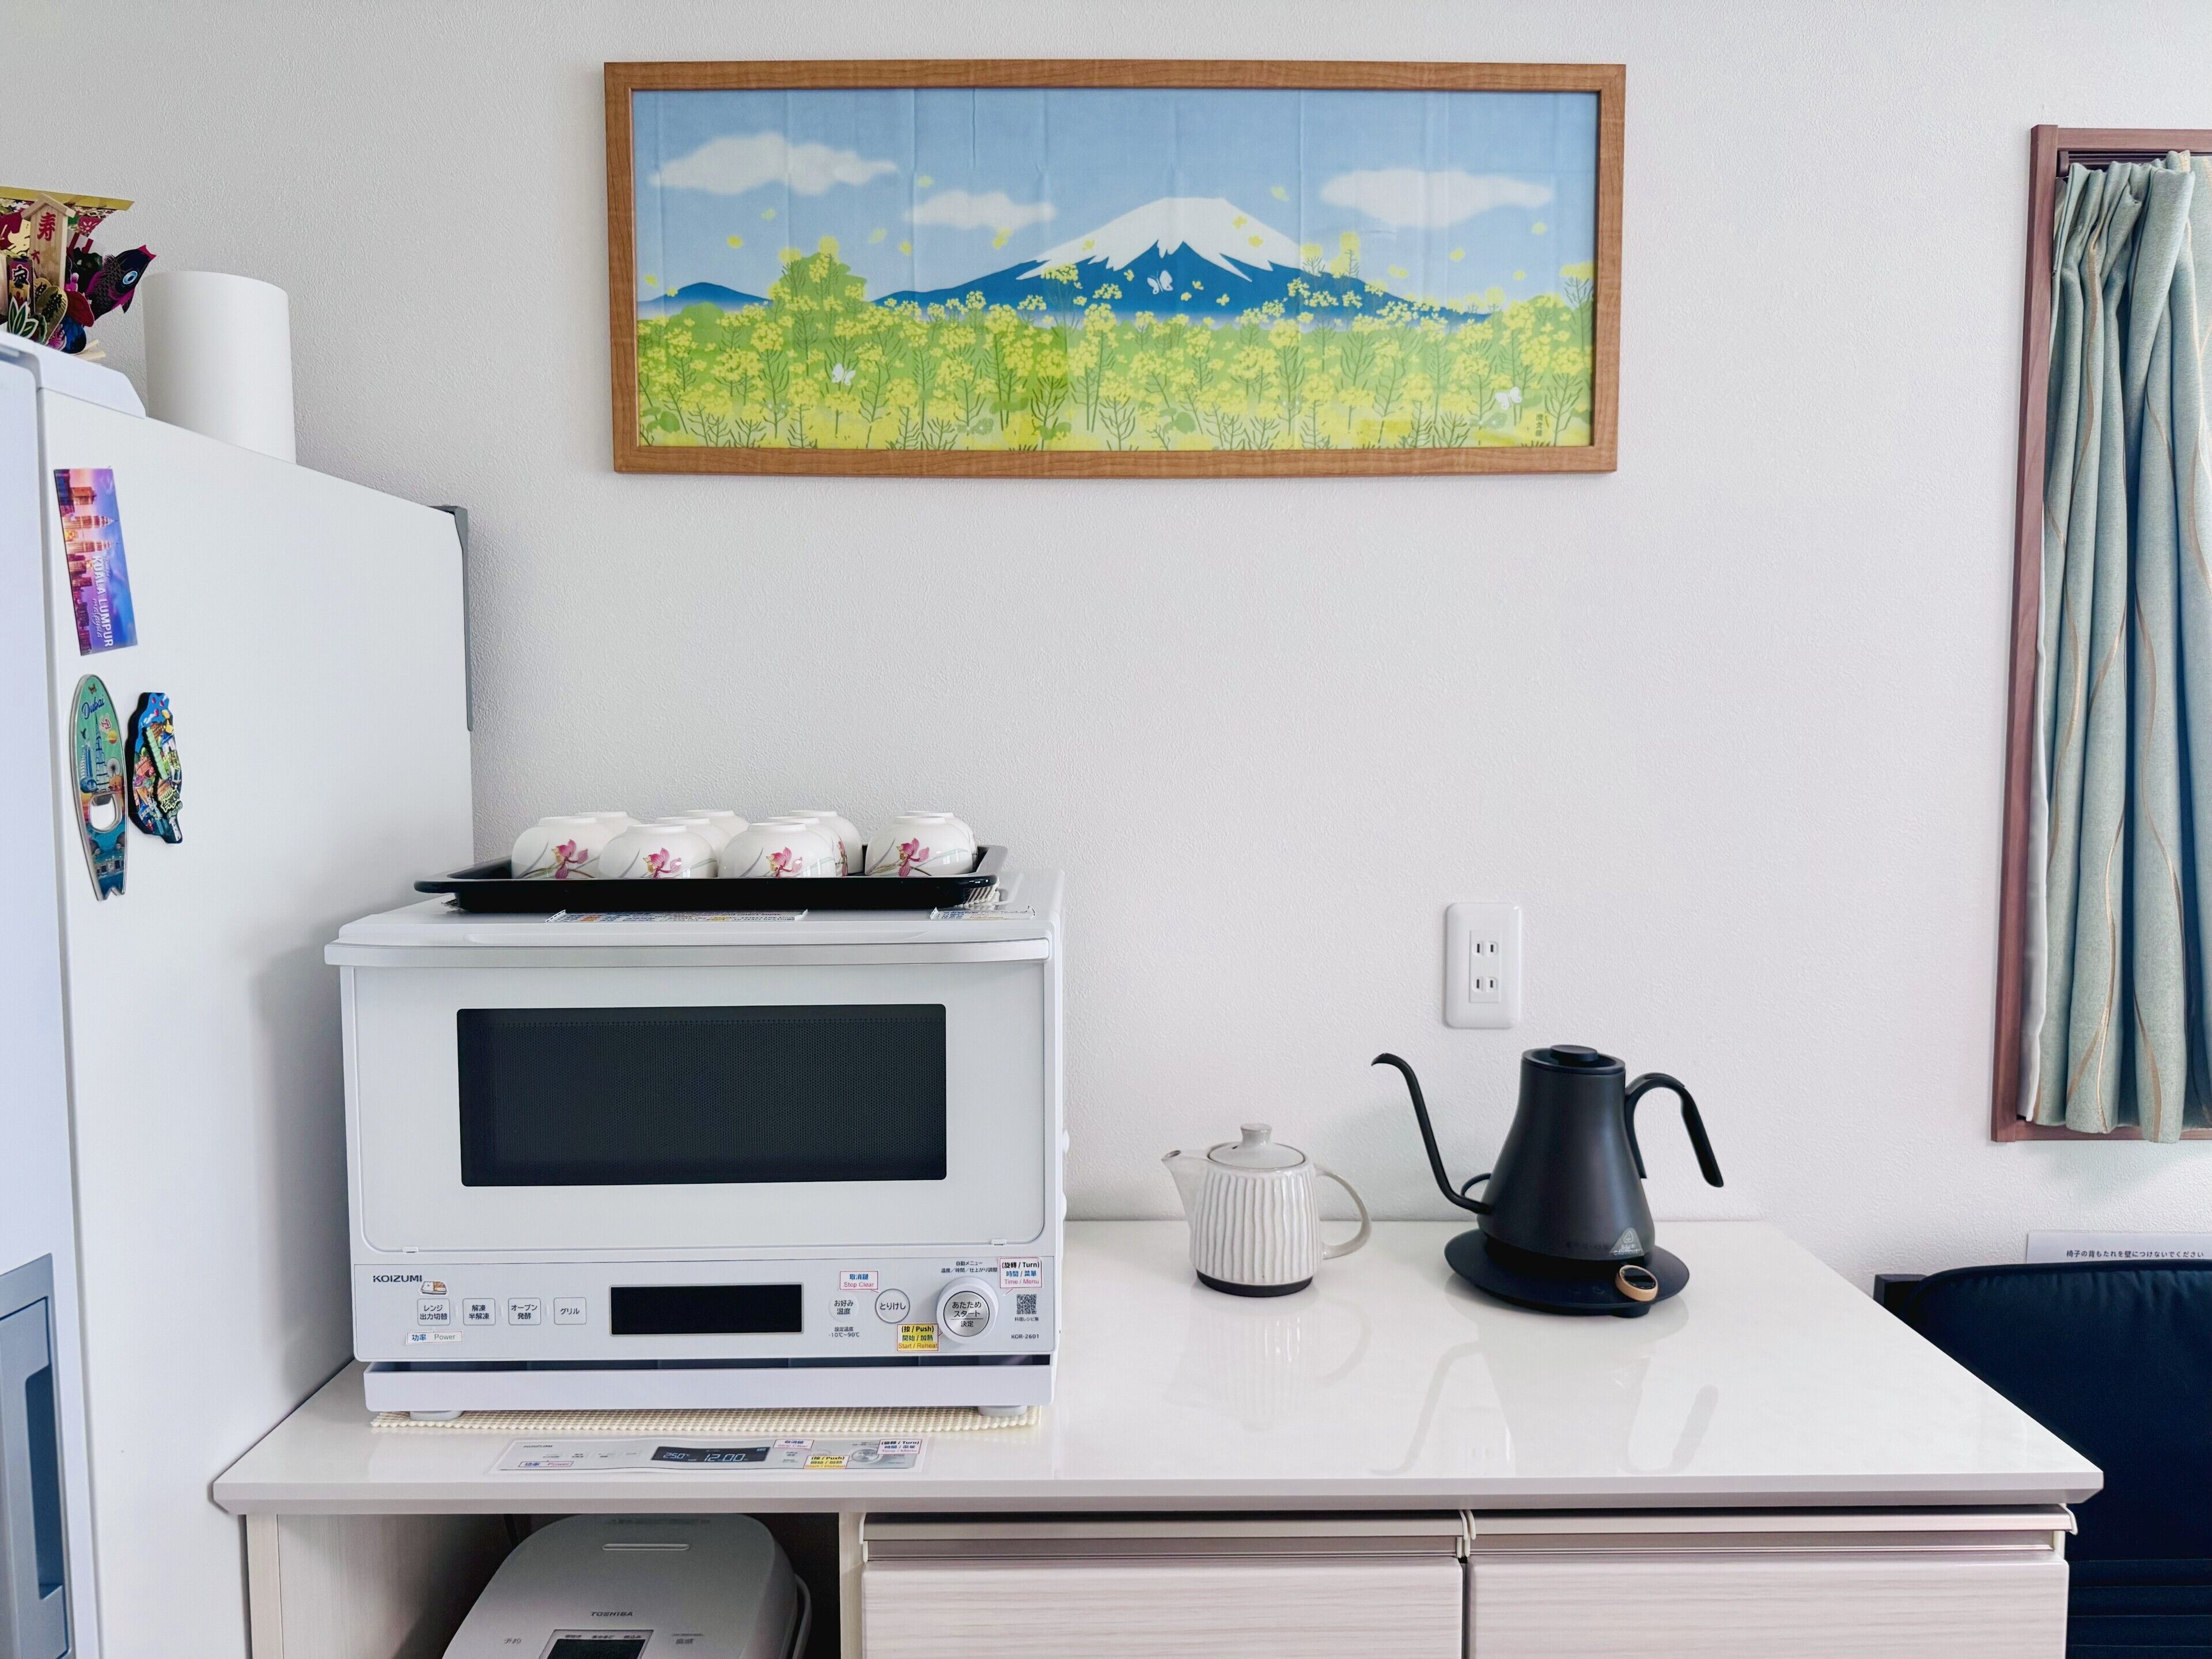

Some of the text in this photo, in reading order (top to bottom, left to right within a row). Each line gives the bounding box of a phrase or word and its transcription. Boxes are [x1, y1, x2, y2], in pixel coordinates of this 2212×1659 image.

[37, 212, 56, 241] 寿
[92, 555, 113, 647] KUALA LUMPUR
[81, 694, 105, 719] Dubai
[2066, 1249, 2204, 1258] 椅子の背もたれを壁につけないでください
